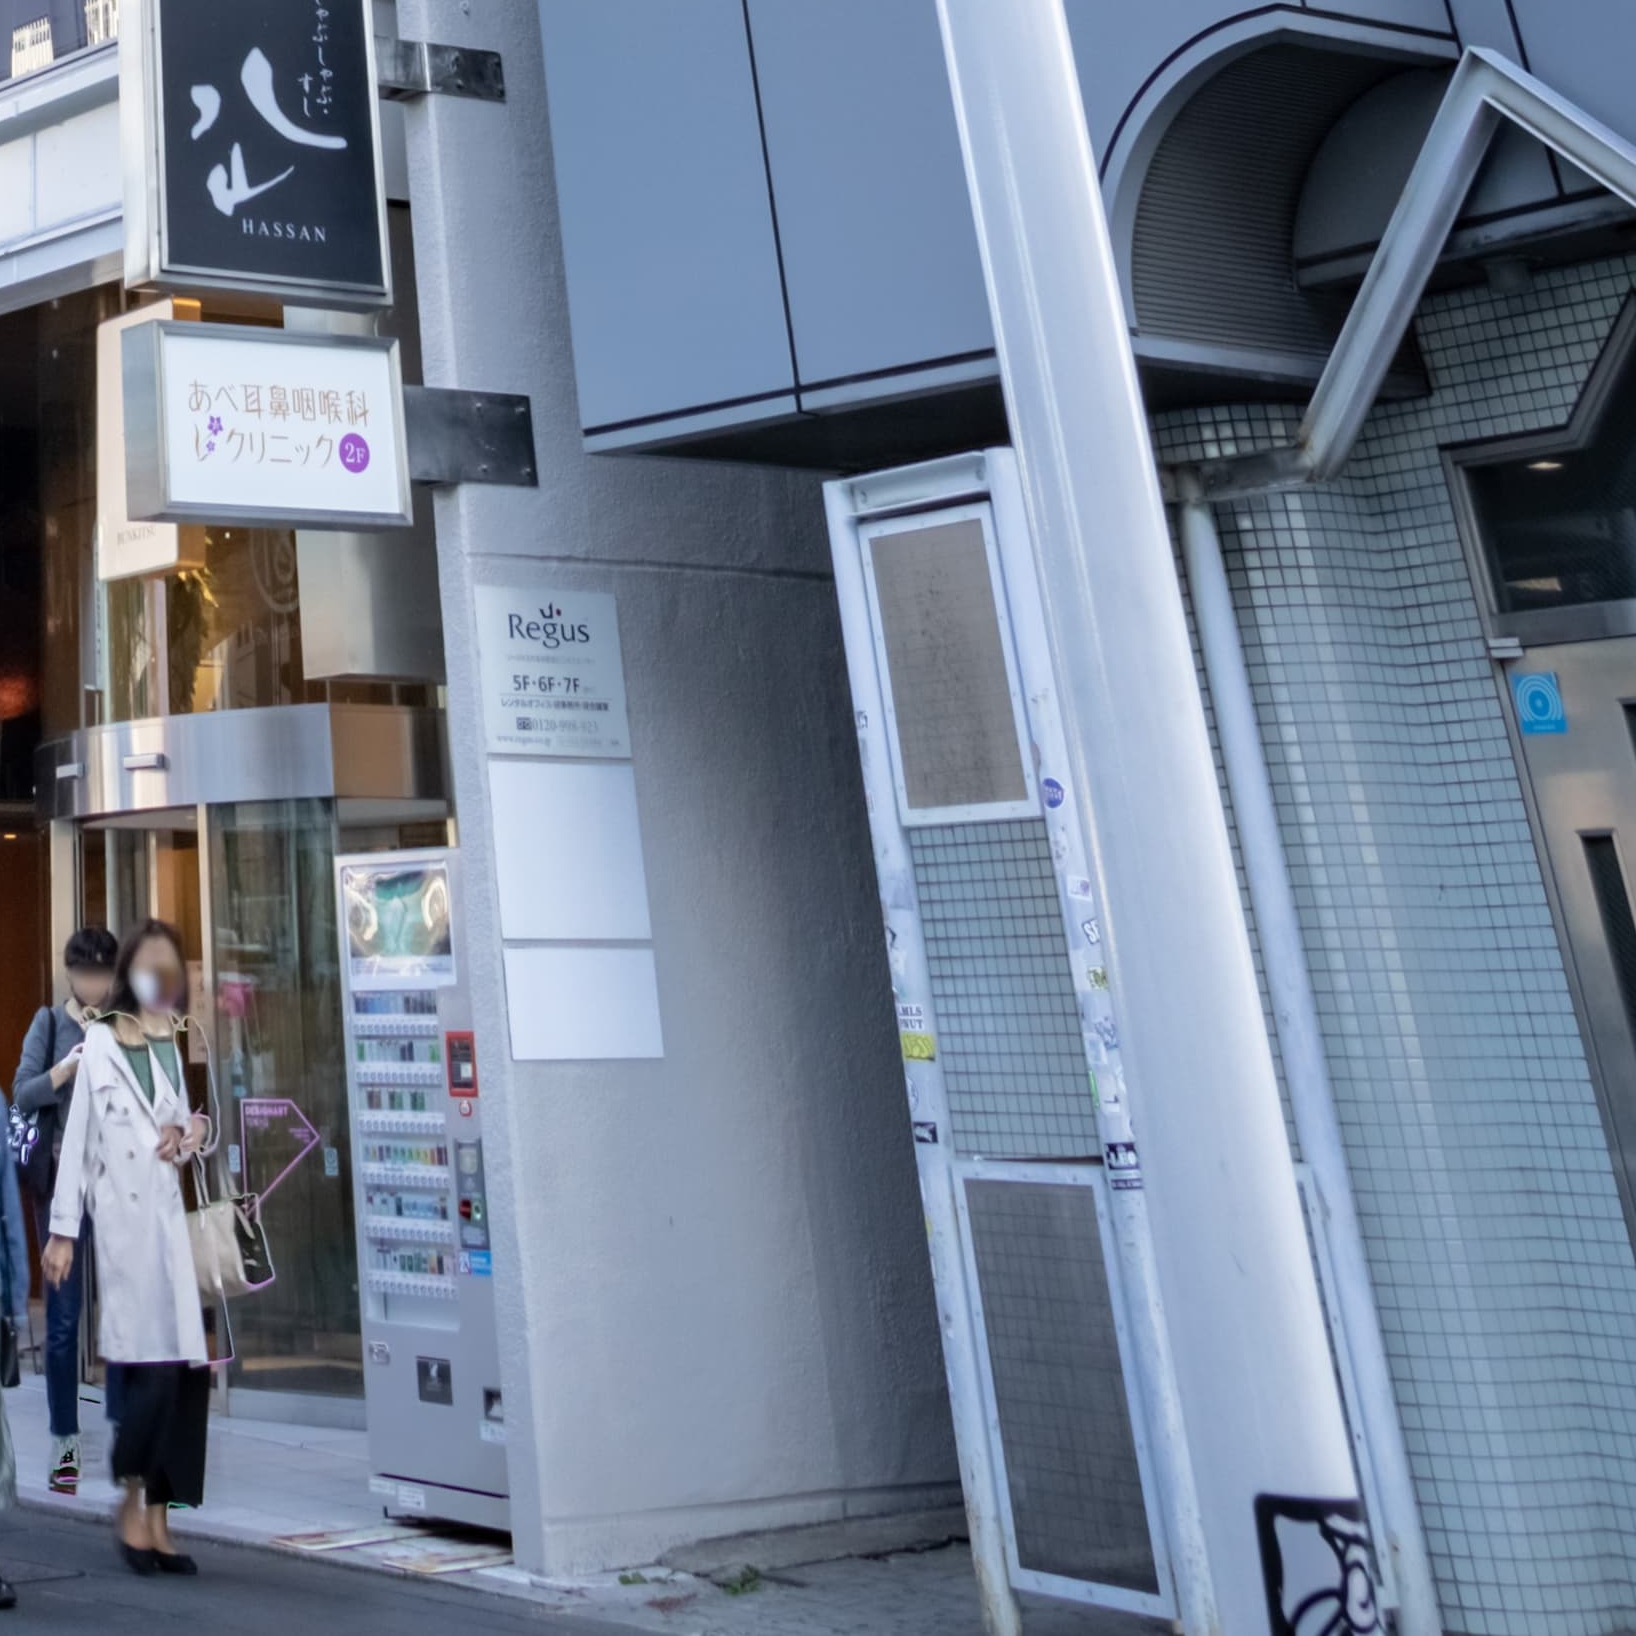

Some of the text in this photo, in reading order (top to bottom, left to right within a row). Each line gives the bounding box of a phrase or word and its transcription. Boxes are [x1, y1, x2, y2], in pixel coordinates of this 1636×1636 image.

[242, 217, 327, 243] HASSAN
[189, 379, 369, 428] あべ耳鼻咽喉科
[226, 432, 366, 467] クリニック 2F
[508, 613, 590, 649] Regus
